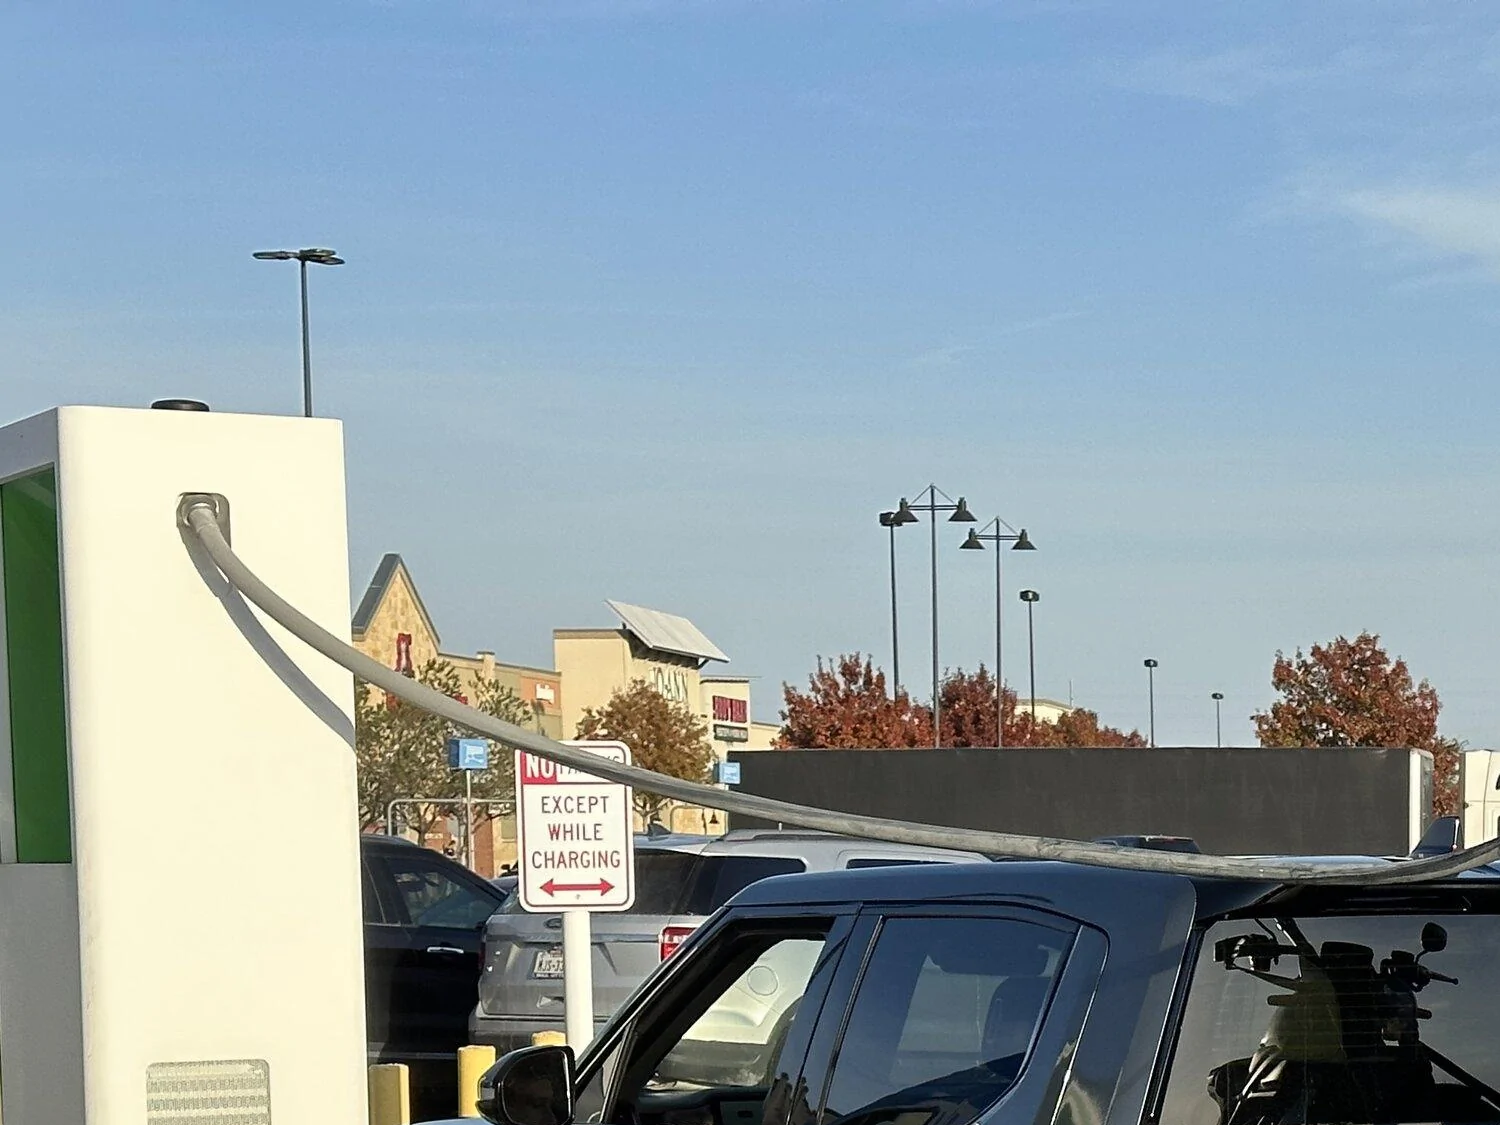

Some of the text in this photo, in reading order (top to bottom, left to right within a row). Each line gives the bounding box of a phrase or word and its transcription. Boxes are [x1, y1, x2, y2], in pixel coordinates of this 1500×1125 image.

[525, 751, 555, 778] NO
[541, 795, 609, 814] EXCEPT
[548, 823, 604, 841] WHILE
[532, 851, 621, 869] CHARGING
